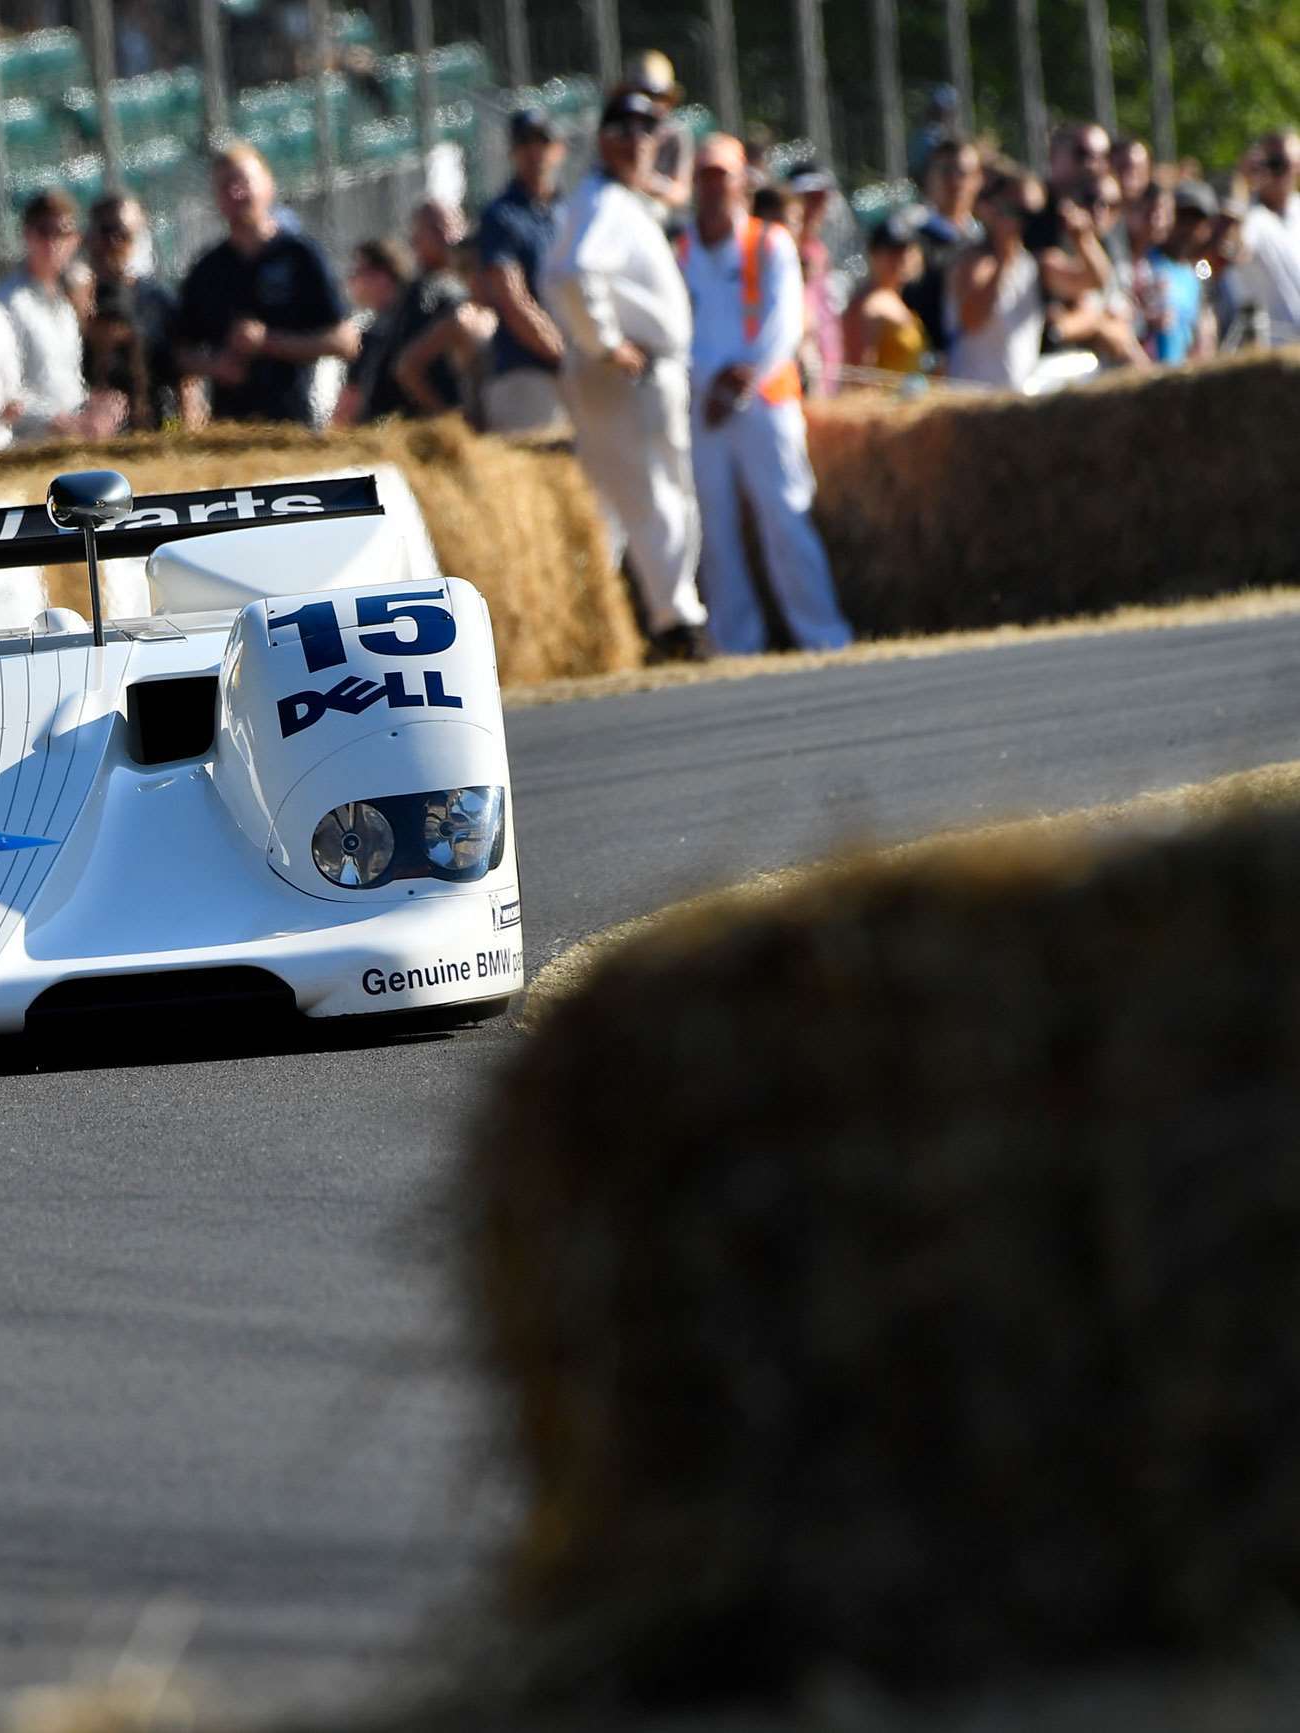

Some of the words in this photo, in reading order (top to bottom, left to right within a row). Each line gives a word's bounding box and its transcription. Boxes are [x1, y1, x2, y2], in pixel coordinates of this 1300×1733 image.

[268, 590, 457, 673] 15
[277, 671, 463, 739] DELL
[362, 958, 471, 996] Genuine
[476, 947, 511, 978] BMW
